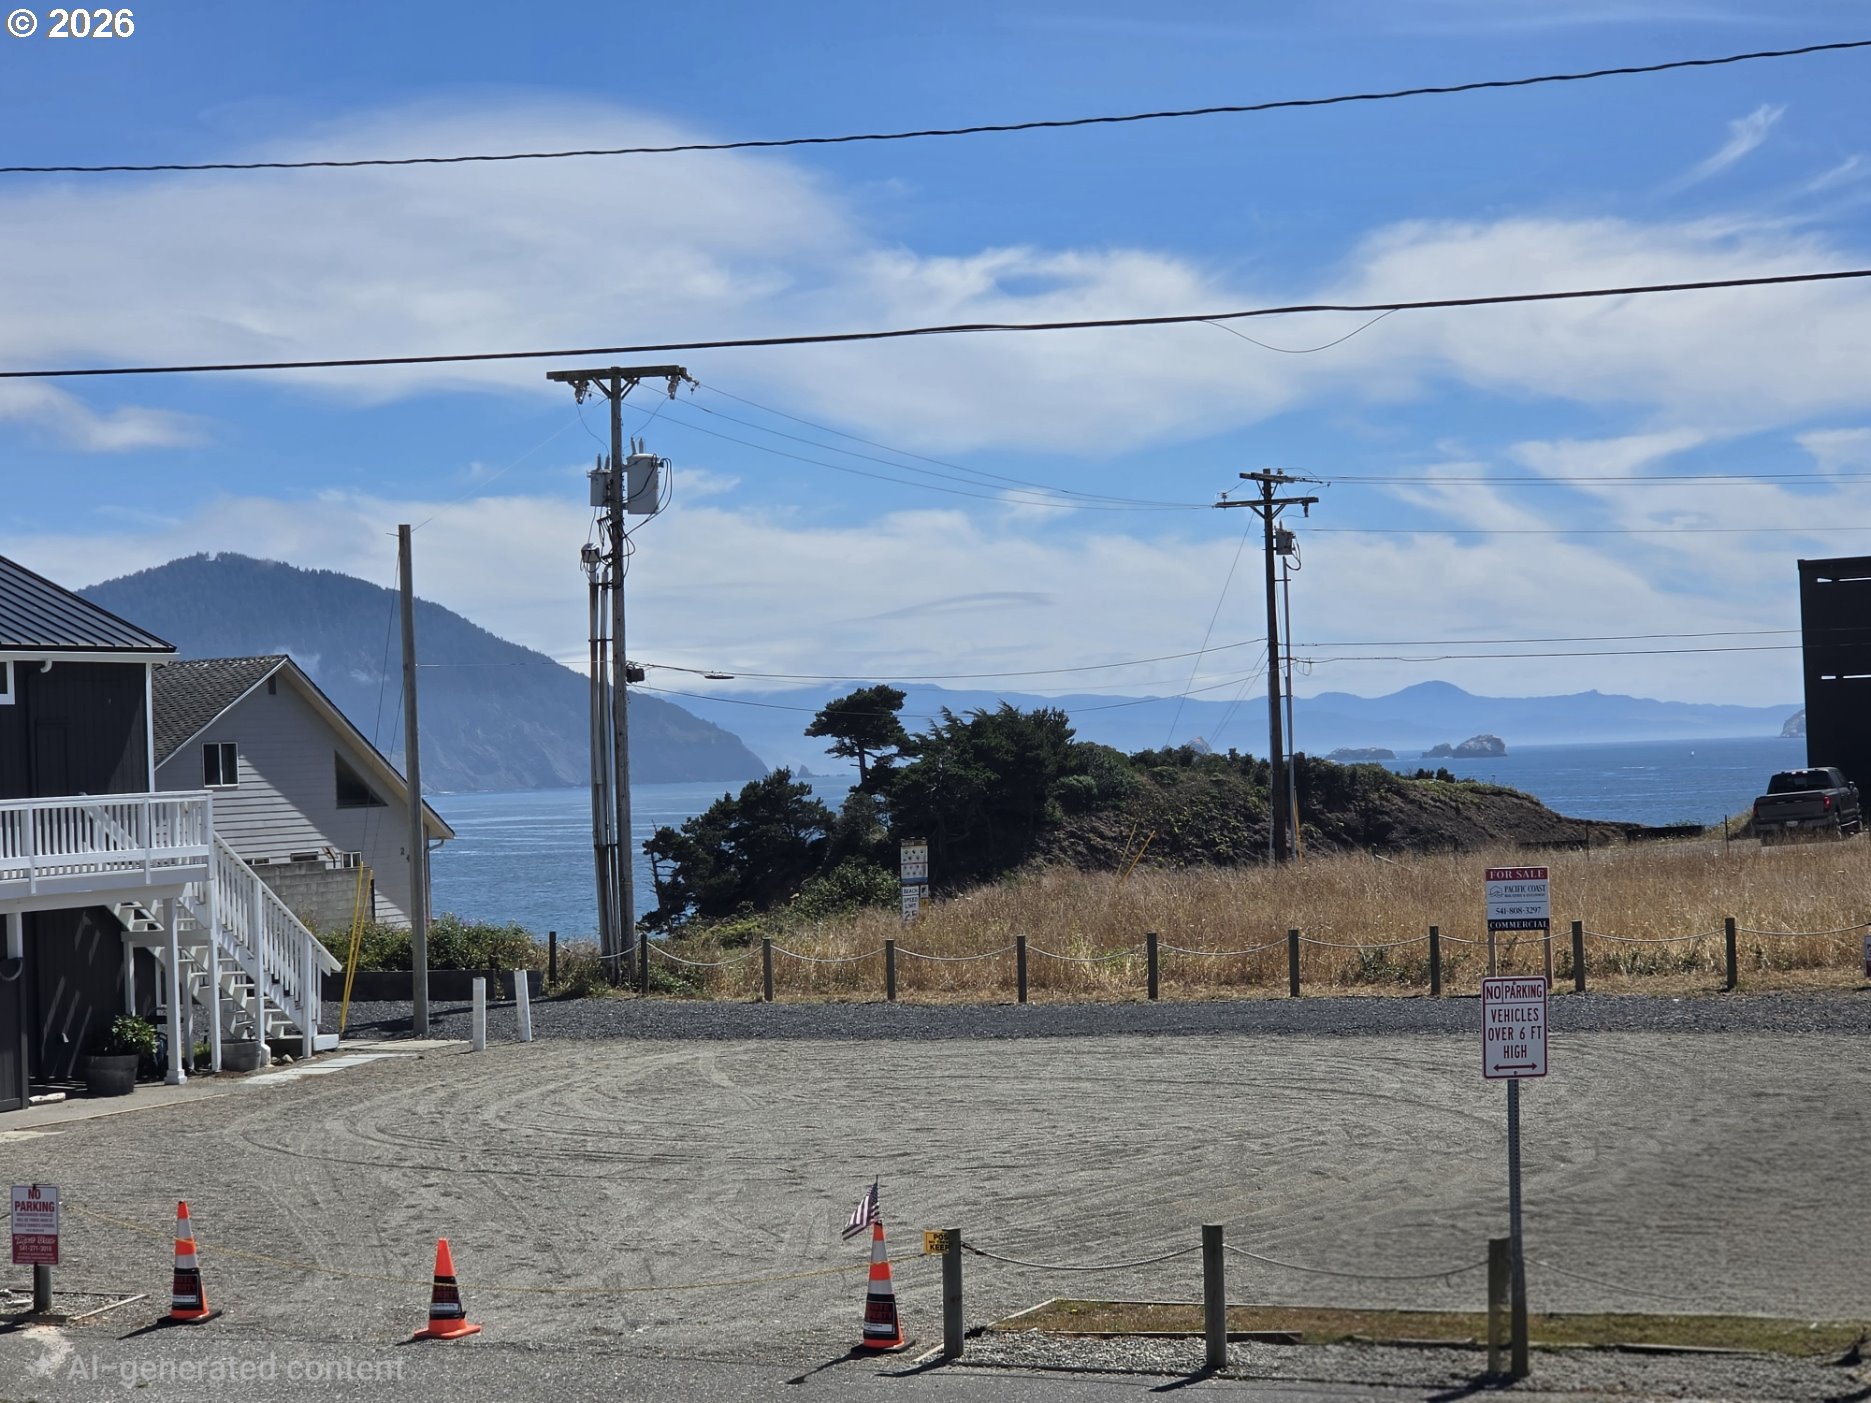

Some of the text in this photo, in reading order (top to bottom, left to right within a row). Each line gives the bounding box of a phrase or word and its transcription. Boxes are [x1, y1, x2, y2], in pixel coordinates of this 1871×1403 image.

[1490, 870, 1544, 879] FOR SALE
[1504, 885, 1526, 893] PACIFIC
[1489, 920, 1547, 929] COMMERCIAL
[1486, 984, 1543, 1000] NO PARKING
[1491, 1008, 1539, 1023] VEHICLES
[1488, 1025, 1542, 1041] OVER 6 FT
[1503, 1044, 1528, 1059] HIGH
[28, 1188, 41, 1199] NO
[14, 1201, 55, 1212] PARKING
